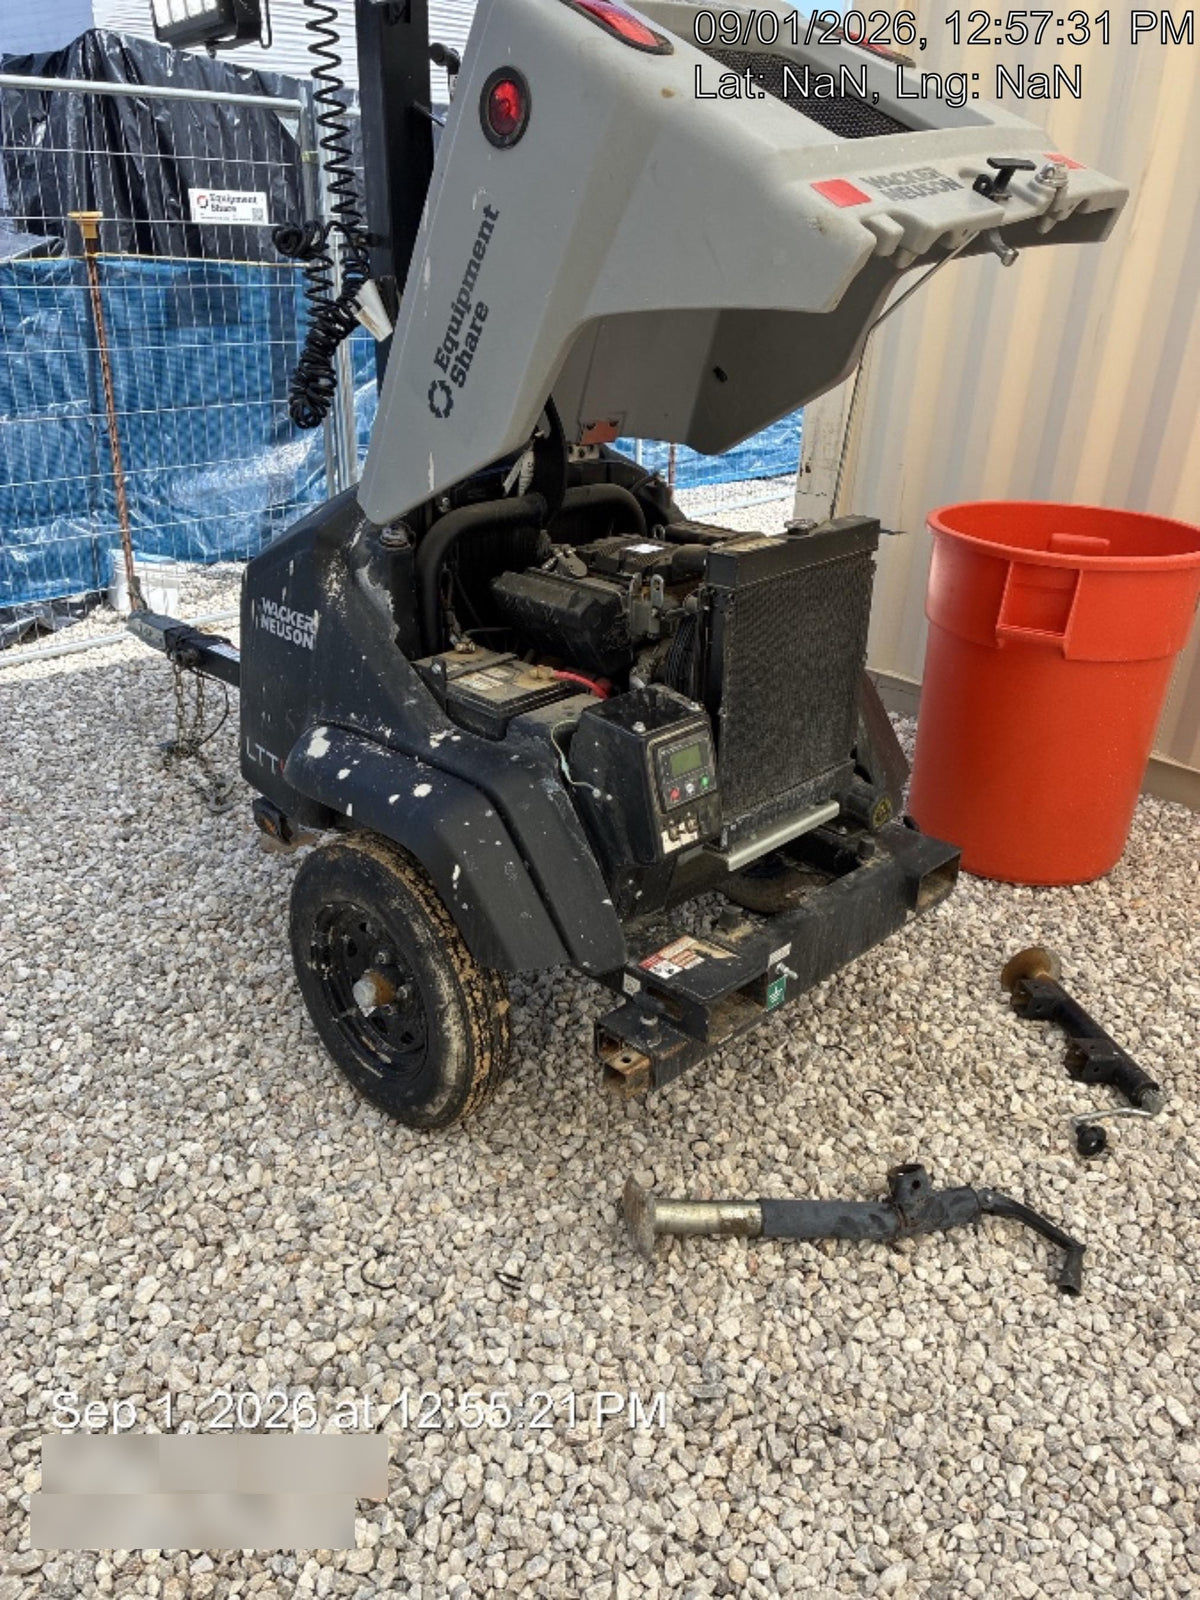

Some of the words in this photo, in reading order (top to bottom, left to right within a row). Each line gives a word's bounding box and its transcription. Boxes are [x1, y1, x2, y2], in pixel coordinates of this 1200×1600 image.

[858, 167, 942, 189] WACKER
[879, 177, 965, 202] NEUSON
[209, 193, 257, 205] Equipment
[210, 204, 237, 213] Share
[433, 203, 501, 374] Equipment
[449, 301, 490, 388] Share
[260, 614, 315, 651] NEUSON
[261, 597, 317, 635] WACKER
[245, 735, 285, 776] LTT
